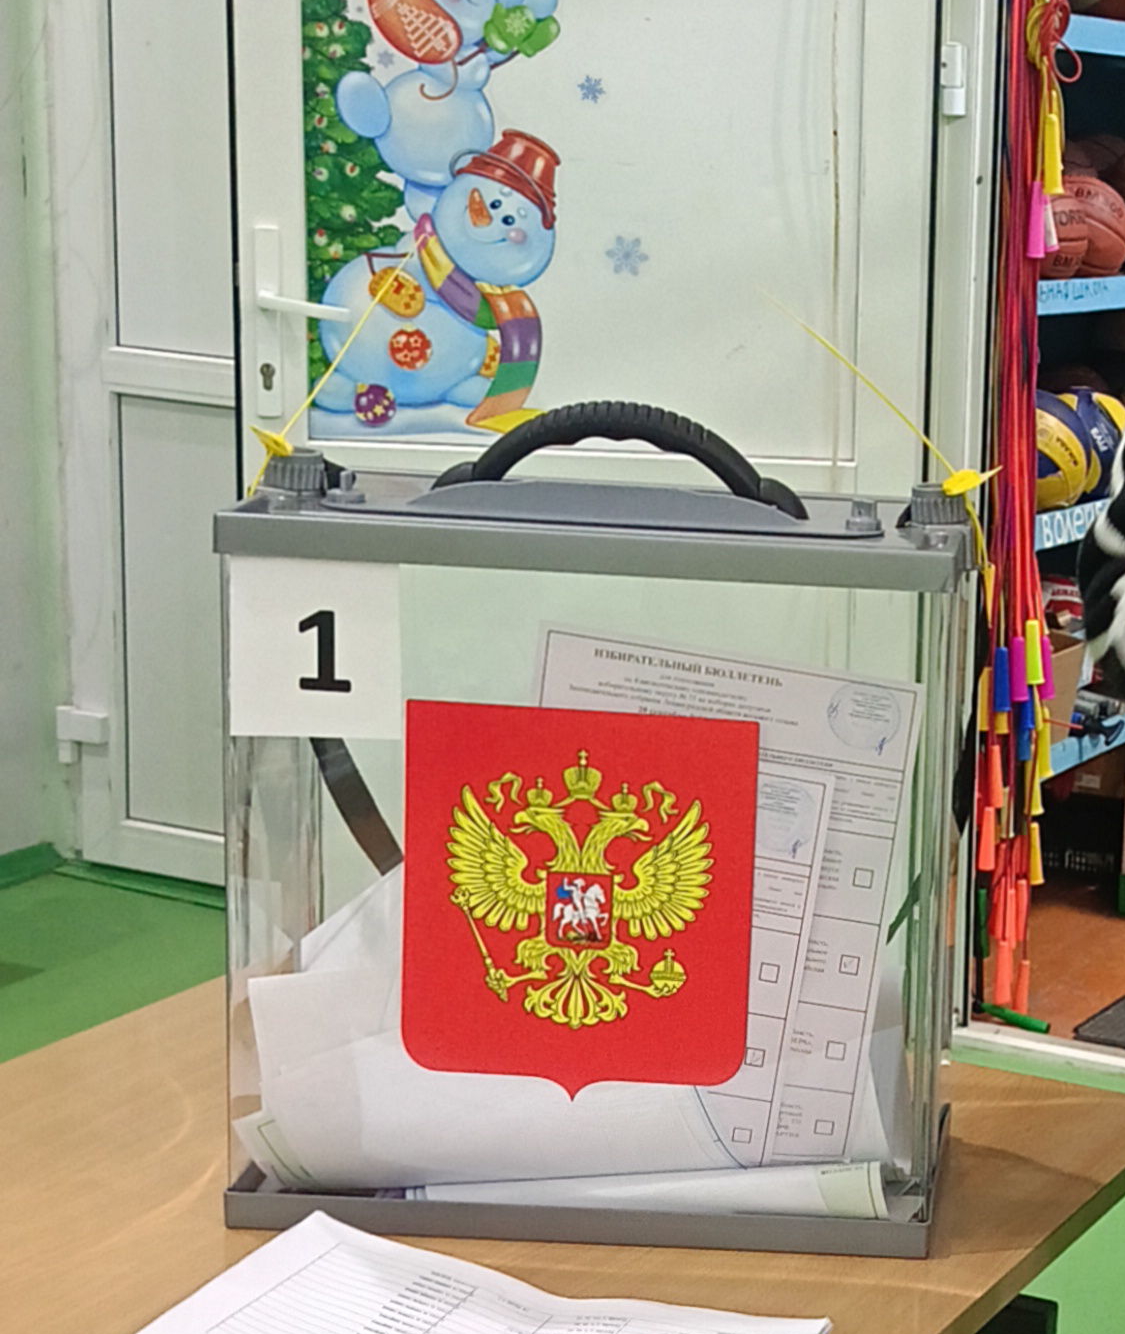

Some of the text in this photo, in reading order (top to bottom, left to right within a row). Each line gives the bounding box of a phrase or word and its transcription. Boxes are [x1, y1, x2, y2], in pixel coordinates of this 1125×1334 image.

[298, 609, 352, 693] 1
[593, 647, 702, 675] ИЗБИРАТЕЛЬНЫЙ
[704, 665, 784, 688] БЮЛЛЕТЕНЬ
